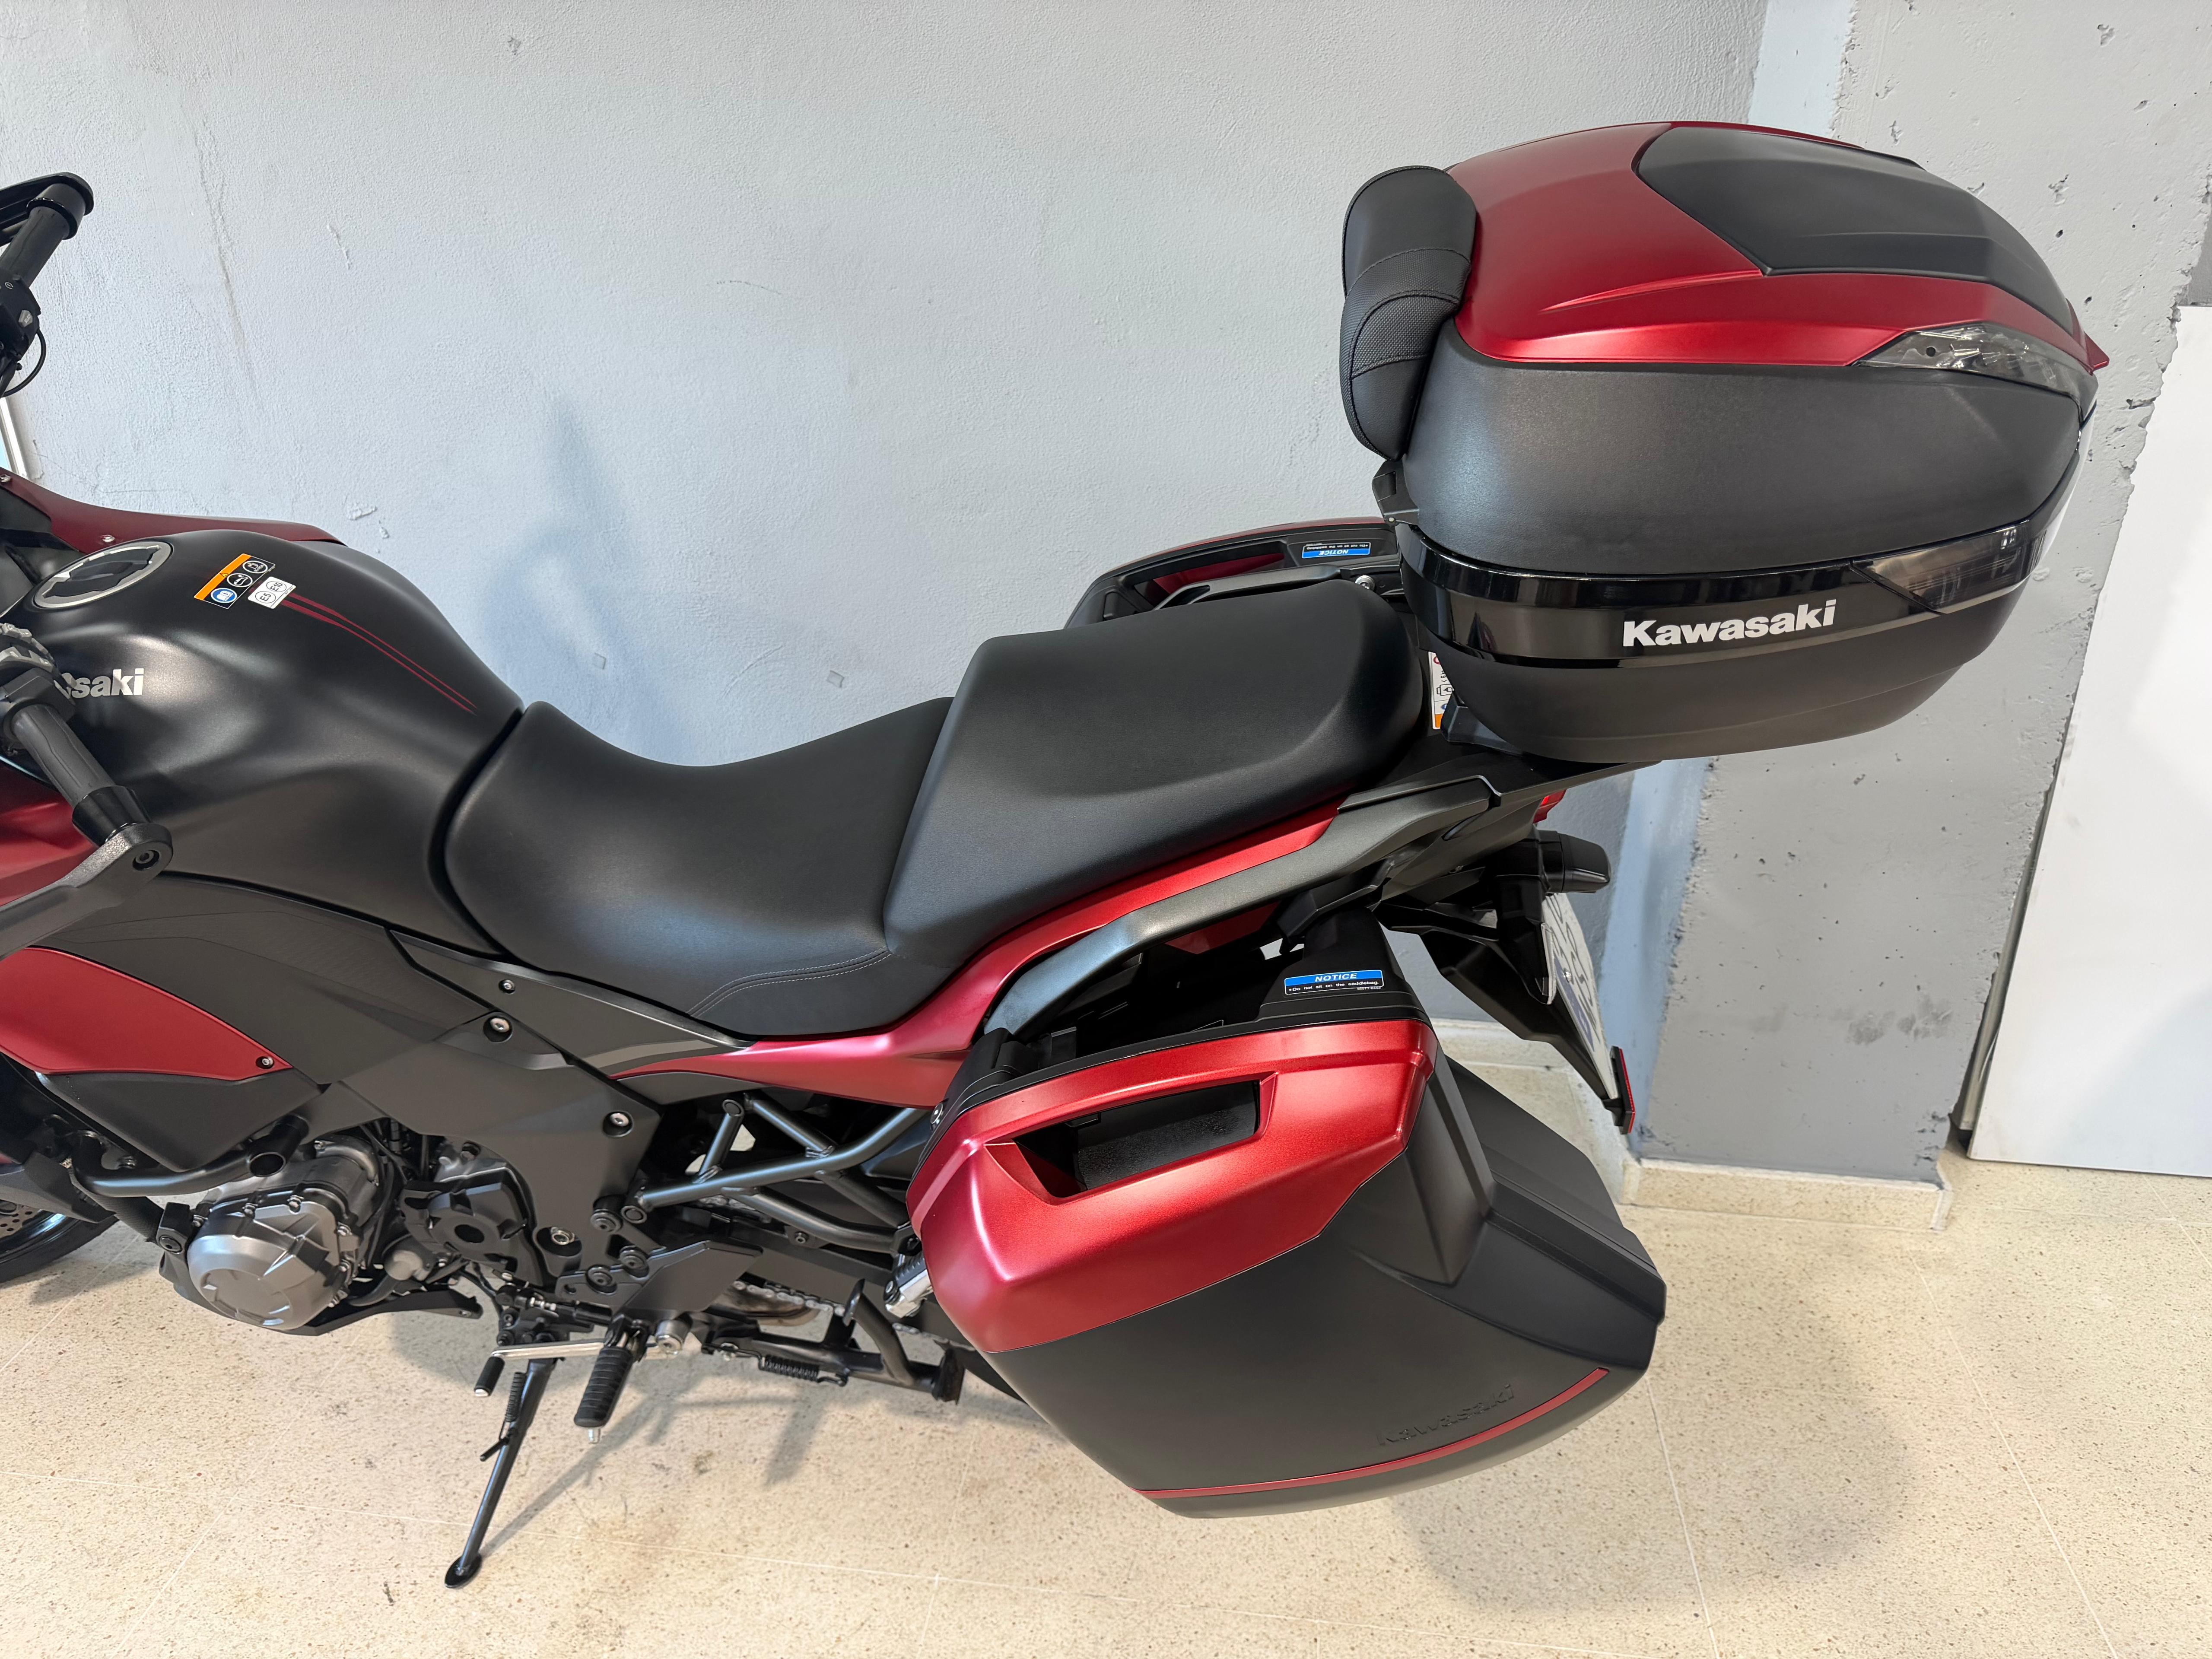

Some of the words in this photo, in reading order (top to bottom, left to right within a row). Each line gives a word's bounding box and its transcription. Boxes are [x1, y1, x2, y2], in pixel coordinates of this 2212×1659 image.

[270, 582, 283, 591] E10
[259, 593, 271, 601] E5
[1623, 599, 1836, 647] Kawasaki
[67, 668, 144, 698] saki
[1314, 973, 1358, 982] NOTICE
[1376, 1384, 1515, 1446] Kawasaki
